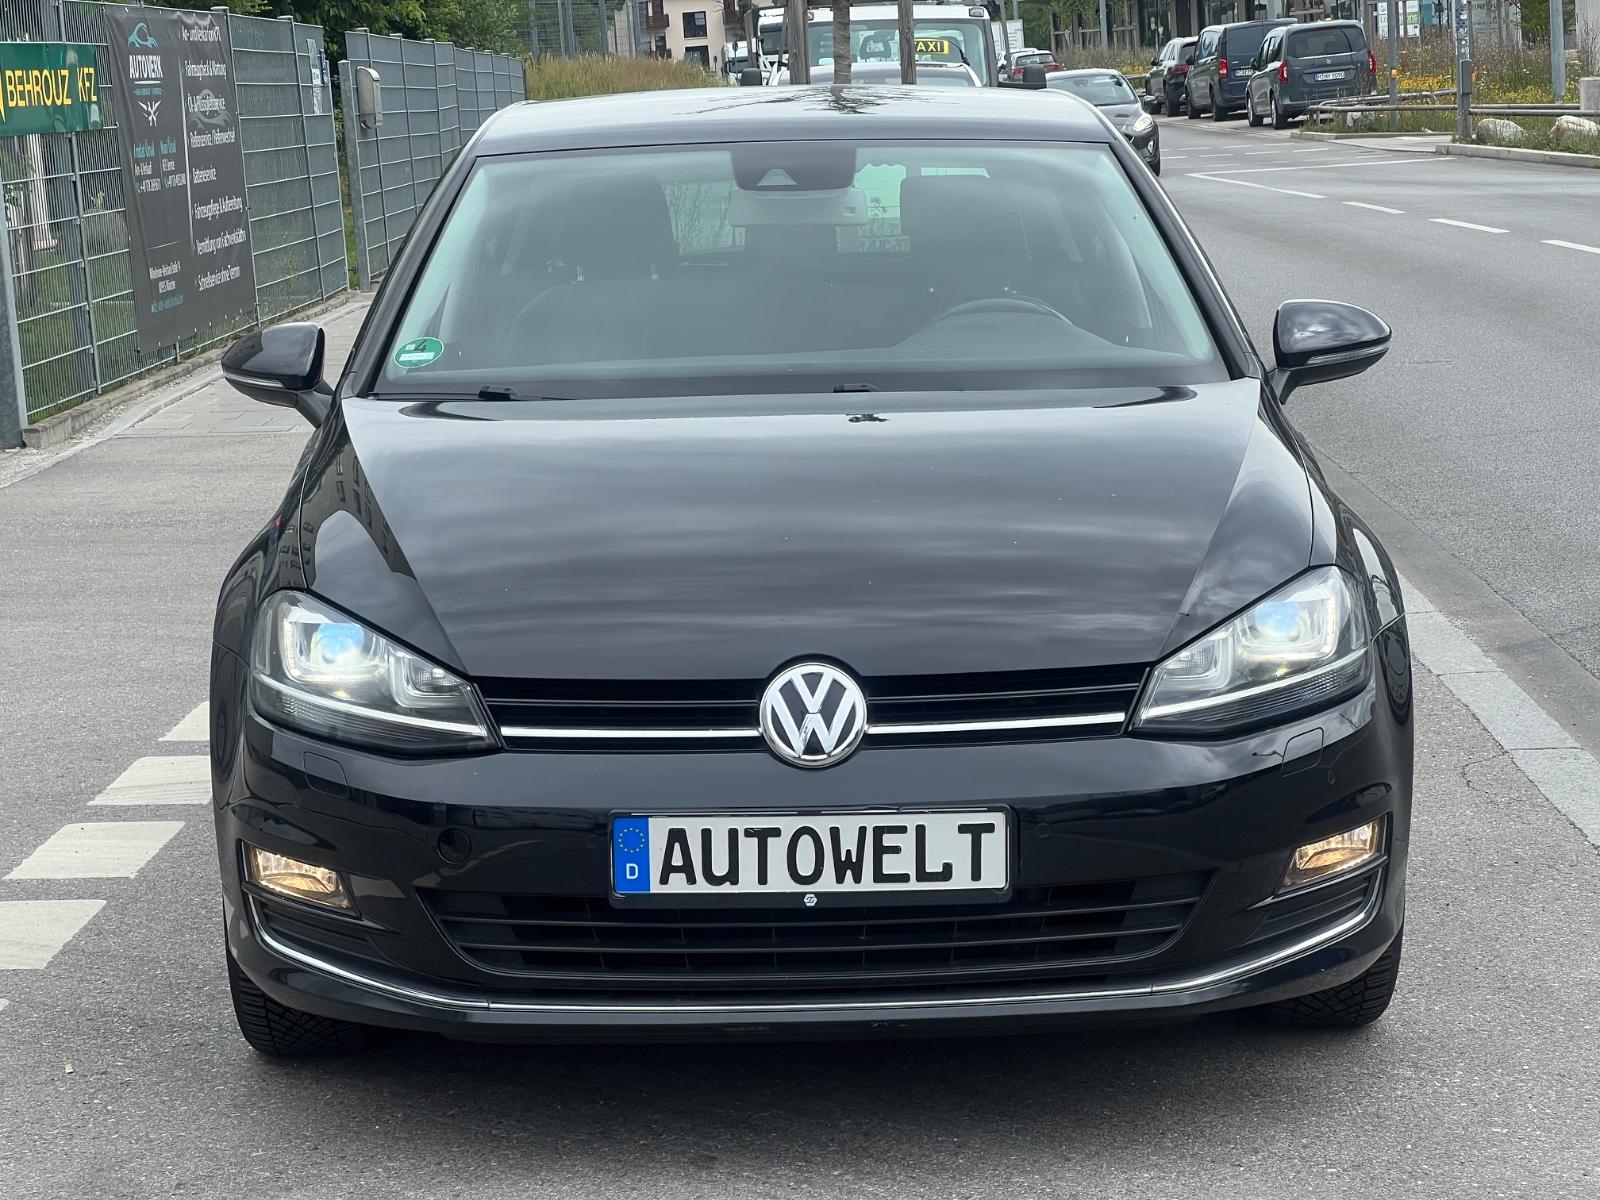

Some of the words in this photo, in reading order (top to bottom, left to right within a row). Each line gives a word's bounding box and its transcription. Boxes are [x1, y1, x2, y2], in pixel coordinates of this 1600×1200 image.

[5, 69, 72, 107] BEHROUZ
[77, 67, 97, 102] KFZ
[626, 863, 639, 880] D
[659, 822, 996, 886] AUTOWELT
